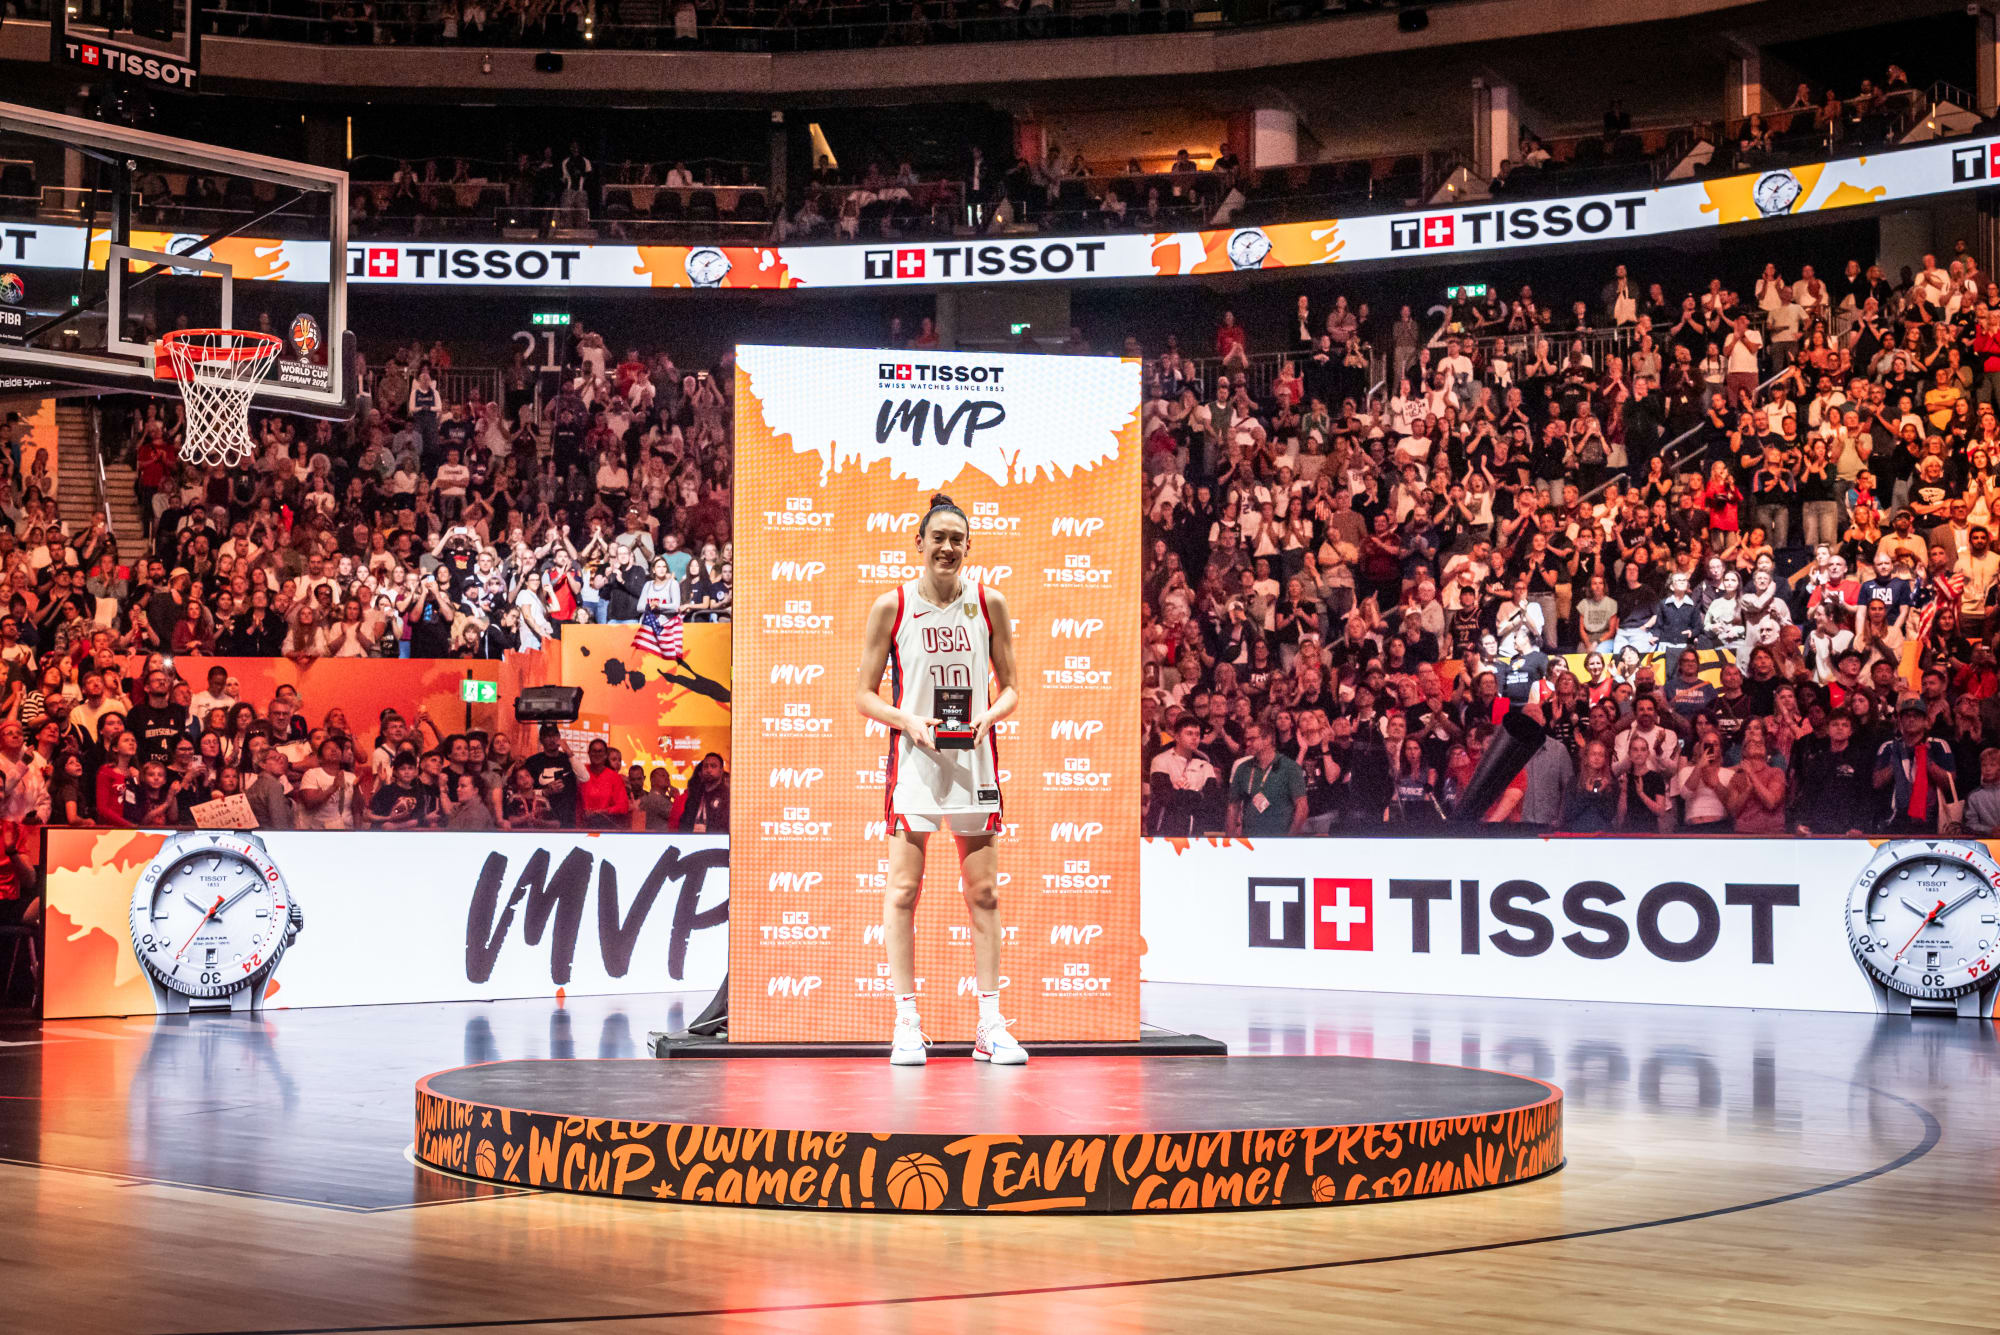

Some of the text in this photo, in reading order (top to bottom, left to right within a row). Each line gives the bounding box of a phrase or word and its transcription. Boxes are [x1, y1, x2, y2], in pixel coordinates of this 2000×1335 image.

[102, 48, 197, 88] TISSOT
[1461, 197, 1647, 244] TISSOT
[406, 248, 580, 280] TISSOT
[933, 241, 1105, 276] TISSOT
[0, 311, 21, 326] FIBA
[280, 365, 328, 379] WORLD CUP
[280, 374, 311, 385] GERMANY
[915, 365, 1004, 383] TISSOT
[876, 398, 1006, 448] MVP
[763, 511, 834, 526] TISSOT
[866, 512, 919, 533] MVP
[967, 517, 1021, 530] SSOT
[1051, 517, 1104, 537] MVP
[771, 561, 826, 582] MVP
[857, 565, 925, 579] TISSOT
[961, 565, 1012, 585] MVP
[1043, 568, 1112, 583] TISSOT
[1872, 587, 1893, 605] USA
[763, 614, 834, 628] TISSOT
[1051, 618, 1104, 638] MVP
[922, 626, 972, 653] USA
[771, 664, 825, 685] MVP
[930, 664, 971, 687] 10
[1043, 670, 1112, 684] TISSOT
[762, 718, 832, 732] TISSOT
[1051, 720, 1104, 740] MVP
[770, 768, 824, 788] MVP
[856, 770, 887, 784] TIS
[1043, 772, 1112, 786] TISSOT
[761, 822, 832, 835] TISSOT
[1051, 822, 1103, 842] MVP
[145, 864, 162, 884] 50
[265, 865, 279, 881] 10
[769, 871, 823, 892] MVP
[1042, 875, 1112, 888] TISSOT
[1859, 869, 1877, 888] 50
[465, 845, 730, 985] MVP
[1388, 878, 1800, 965] TISSOT
[760, 926, 831, 939] TISSOT
[1051, 925, 1103, 945] MVP
[142, 933, 158, 953] 40
[1859, 935, 1876, 953] 40
[242, 953, 262, 973] 24
[1968, 959, 1990, 978] 24
[200, 972, 221, 984] 30
[768, 976, 822, 996] MVP
[855, 978, 925, 991] TISST
[1042, 977, 1111, 991] TISSOT
[1922, 974, 1945, 987] 30
